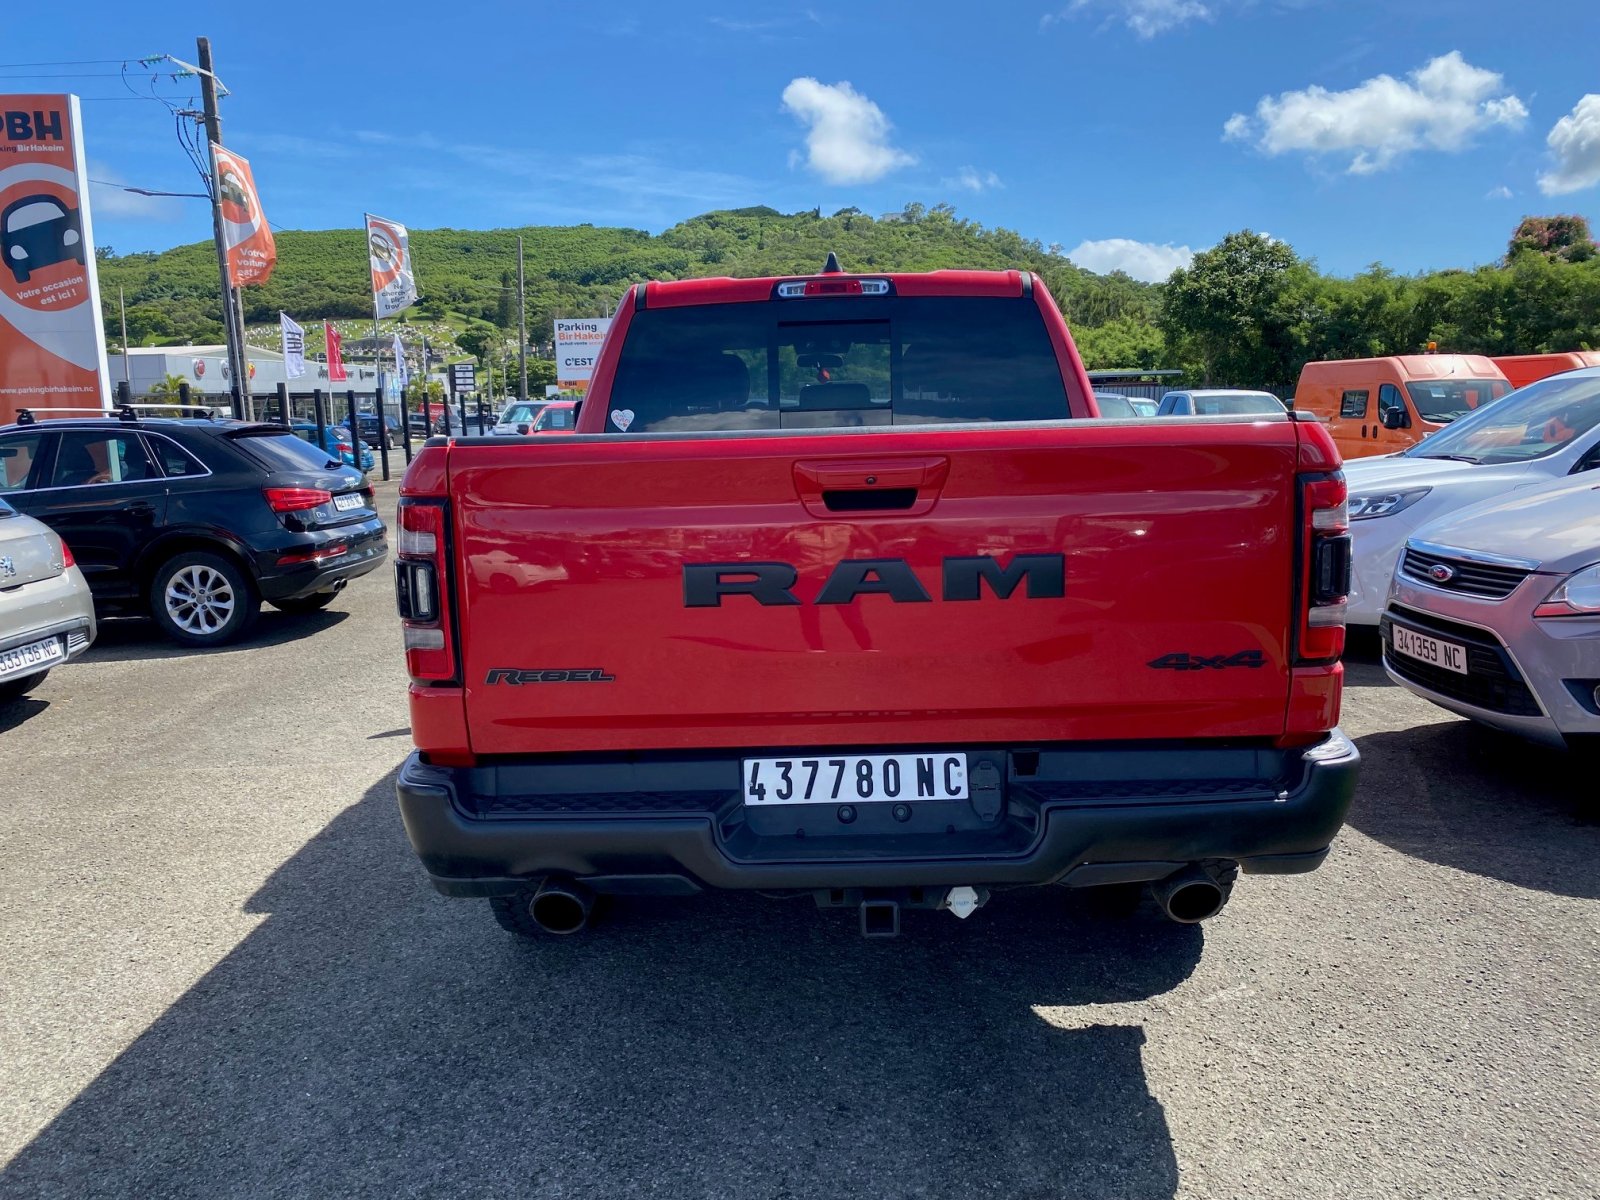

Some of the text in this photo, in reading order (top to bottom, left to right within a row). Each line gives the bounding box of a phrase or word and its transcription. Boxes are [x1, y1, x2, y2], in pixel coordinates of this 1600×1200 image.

[0, 111, 63, 140] BH
[17, 276, 83, 300] Votre occasion
[40, 294, 56, 305] est
[58, 290, 71, 300] ici
[558, 323, 597, 333] Parking
[286, 331, 302, 356] FIAT
[565, 358, 594, 367] C'EST
[682, 552, 1066, 608] RAM
[41, 640, 57, 658] NC
[1397, 629, 1461, 670] 341359 NC
[484, 668, 616, 687] REBEL
[749, 757, 962, 801] 437780 NC
